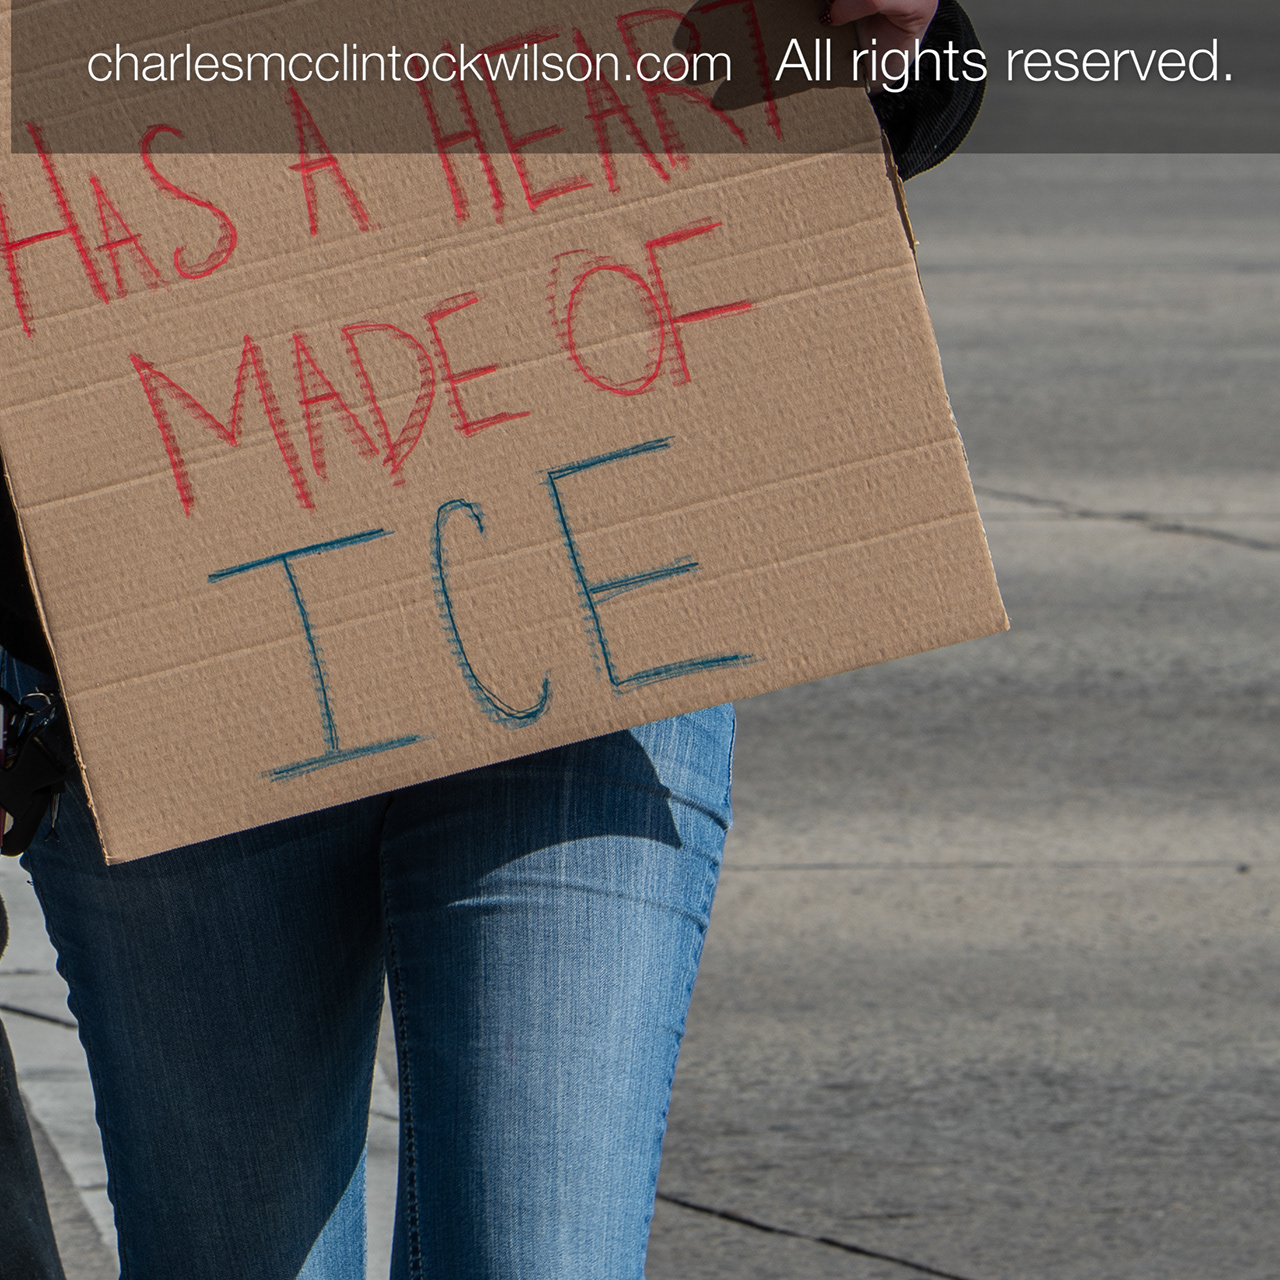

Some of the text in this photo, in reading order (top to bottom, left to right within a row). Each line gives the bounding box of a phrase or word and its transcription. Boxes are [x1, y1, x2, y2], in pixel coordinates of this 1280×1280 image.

[288, 83, 385, 235] A
[128, 216, 755, 517] MADE OF
[205, 435, 768, 783] ICE
